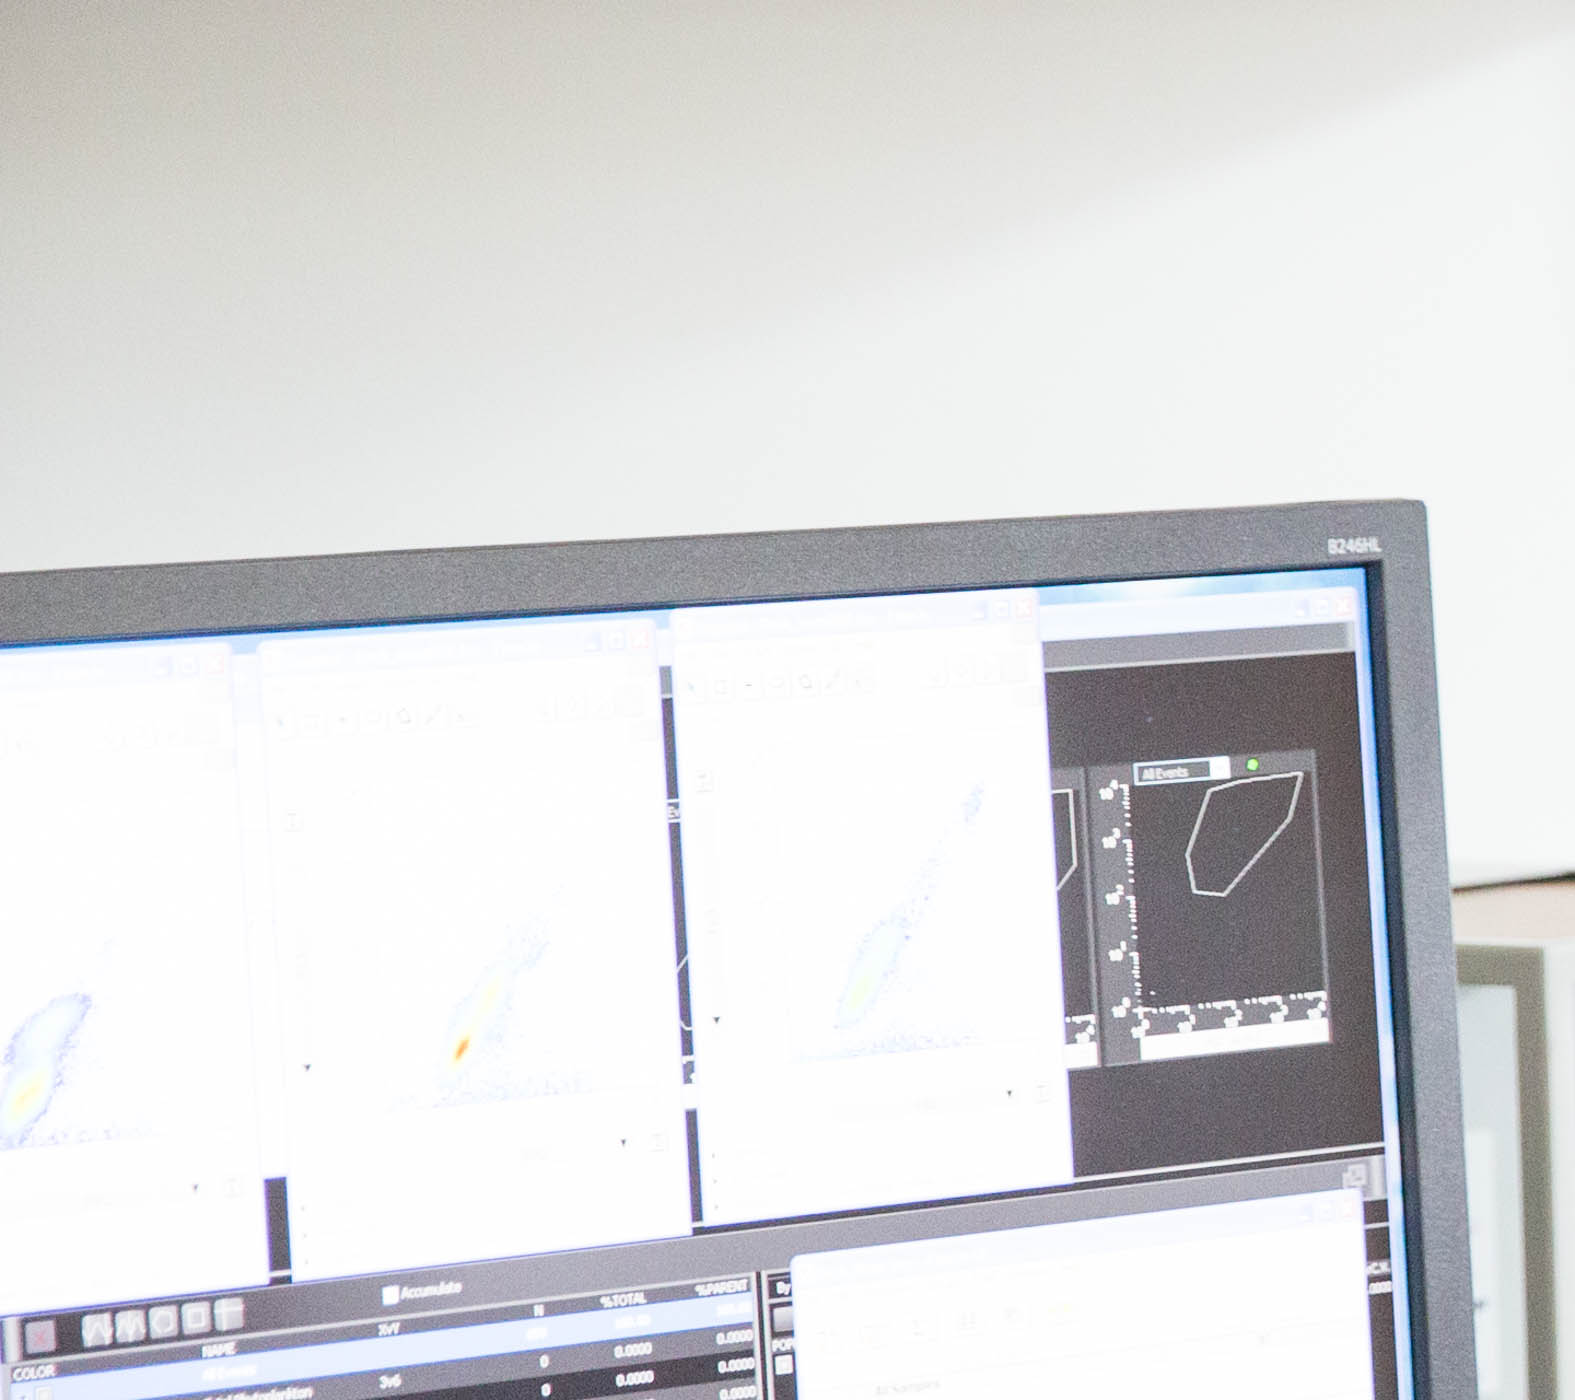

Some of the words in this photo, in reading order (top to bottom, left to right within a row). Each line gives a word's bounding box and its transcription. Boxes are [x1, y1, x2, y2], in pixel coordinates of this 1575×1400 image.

[400, 1280, 463, 1301] Accumulate
[12, 1363, 57, 1383] COLOR
[201, 1341, 238, 1359] NAME
